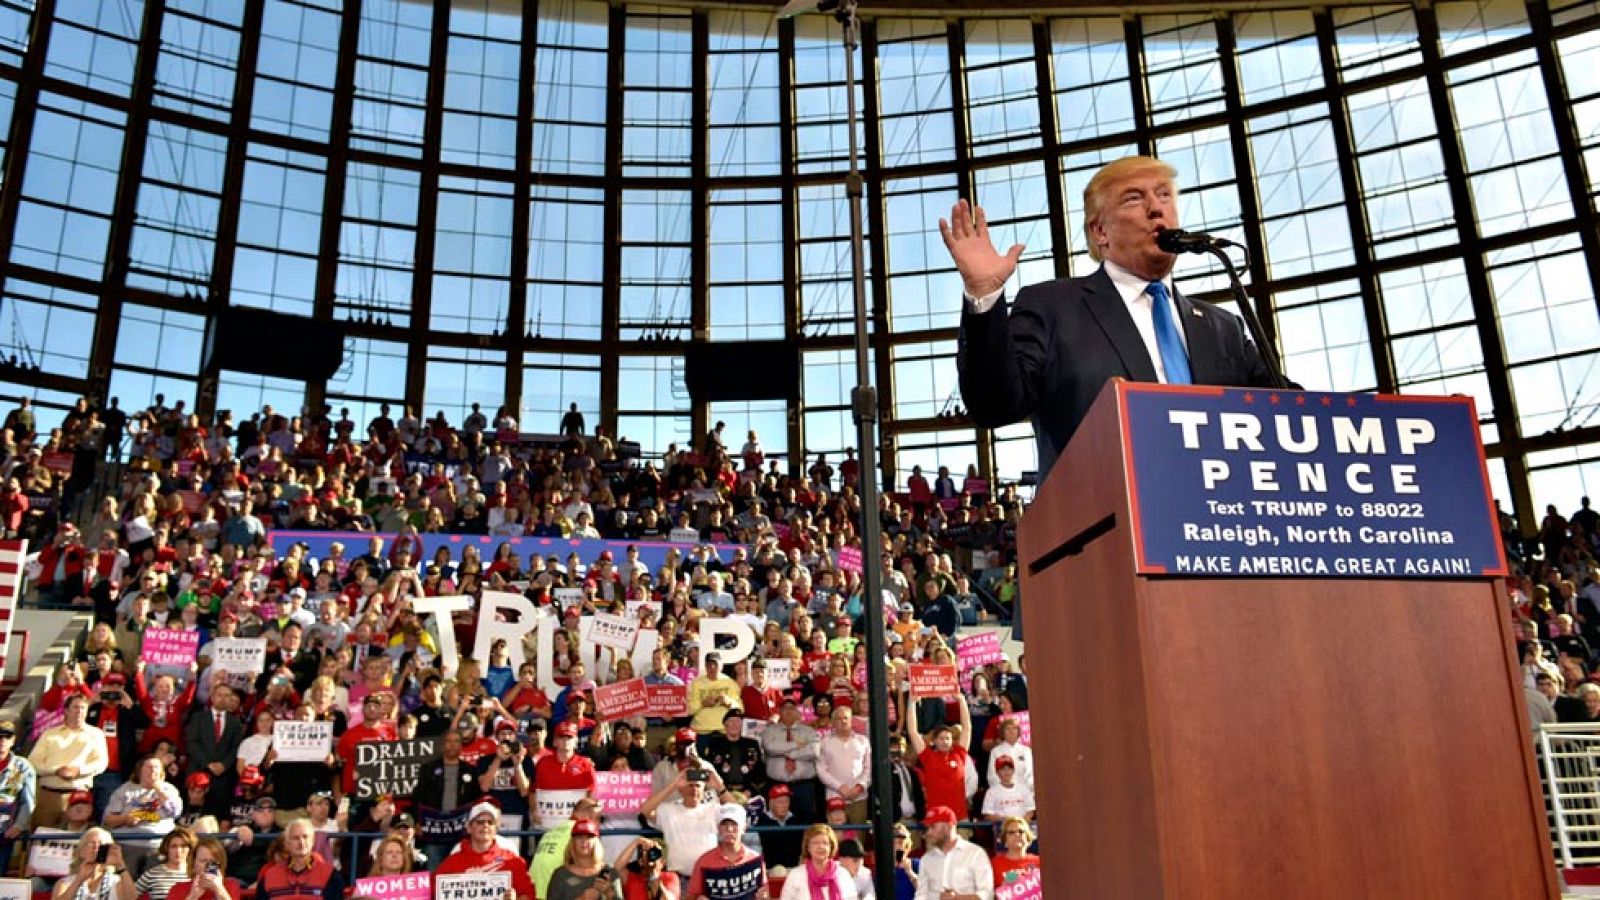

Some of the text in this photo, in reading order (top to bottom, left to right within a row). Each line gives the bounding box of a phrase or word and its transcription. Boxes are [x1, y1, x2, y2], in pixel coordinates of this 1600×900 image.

[1168, 409, 1436, 455] TRUMP
[1201, 459, 1421, 494] PENCE
[1206, 500, 1424, 518] Text TRUMP to 88022
[1183, 523, 1454, 546] Raleigh, North Carolina
[1176, 555, 1472, 575] MAKE AMERICA GREAT AGAIN!
[146, 629, 199, 643] WOMEN
[144, 651, 192, 663] TRUMP
[356, 740, 435, 766] DRAIN
[373, 759, 422, 780] THE
[596, 773, 652, 785] WOMEN
[356, 777, 419, 798] SWAM
[358, 876, 430, 895] WOMEN
[705, 868, 761, 888] TRUMP
[997, 873, 1040, 900] WOM
[442, 886, 505, 899] TRUMP
